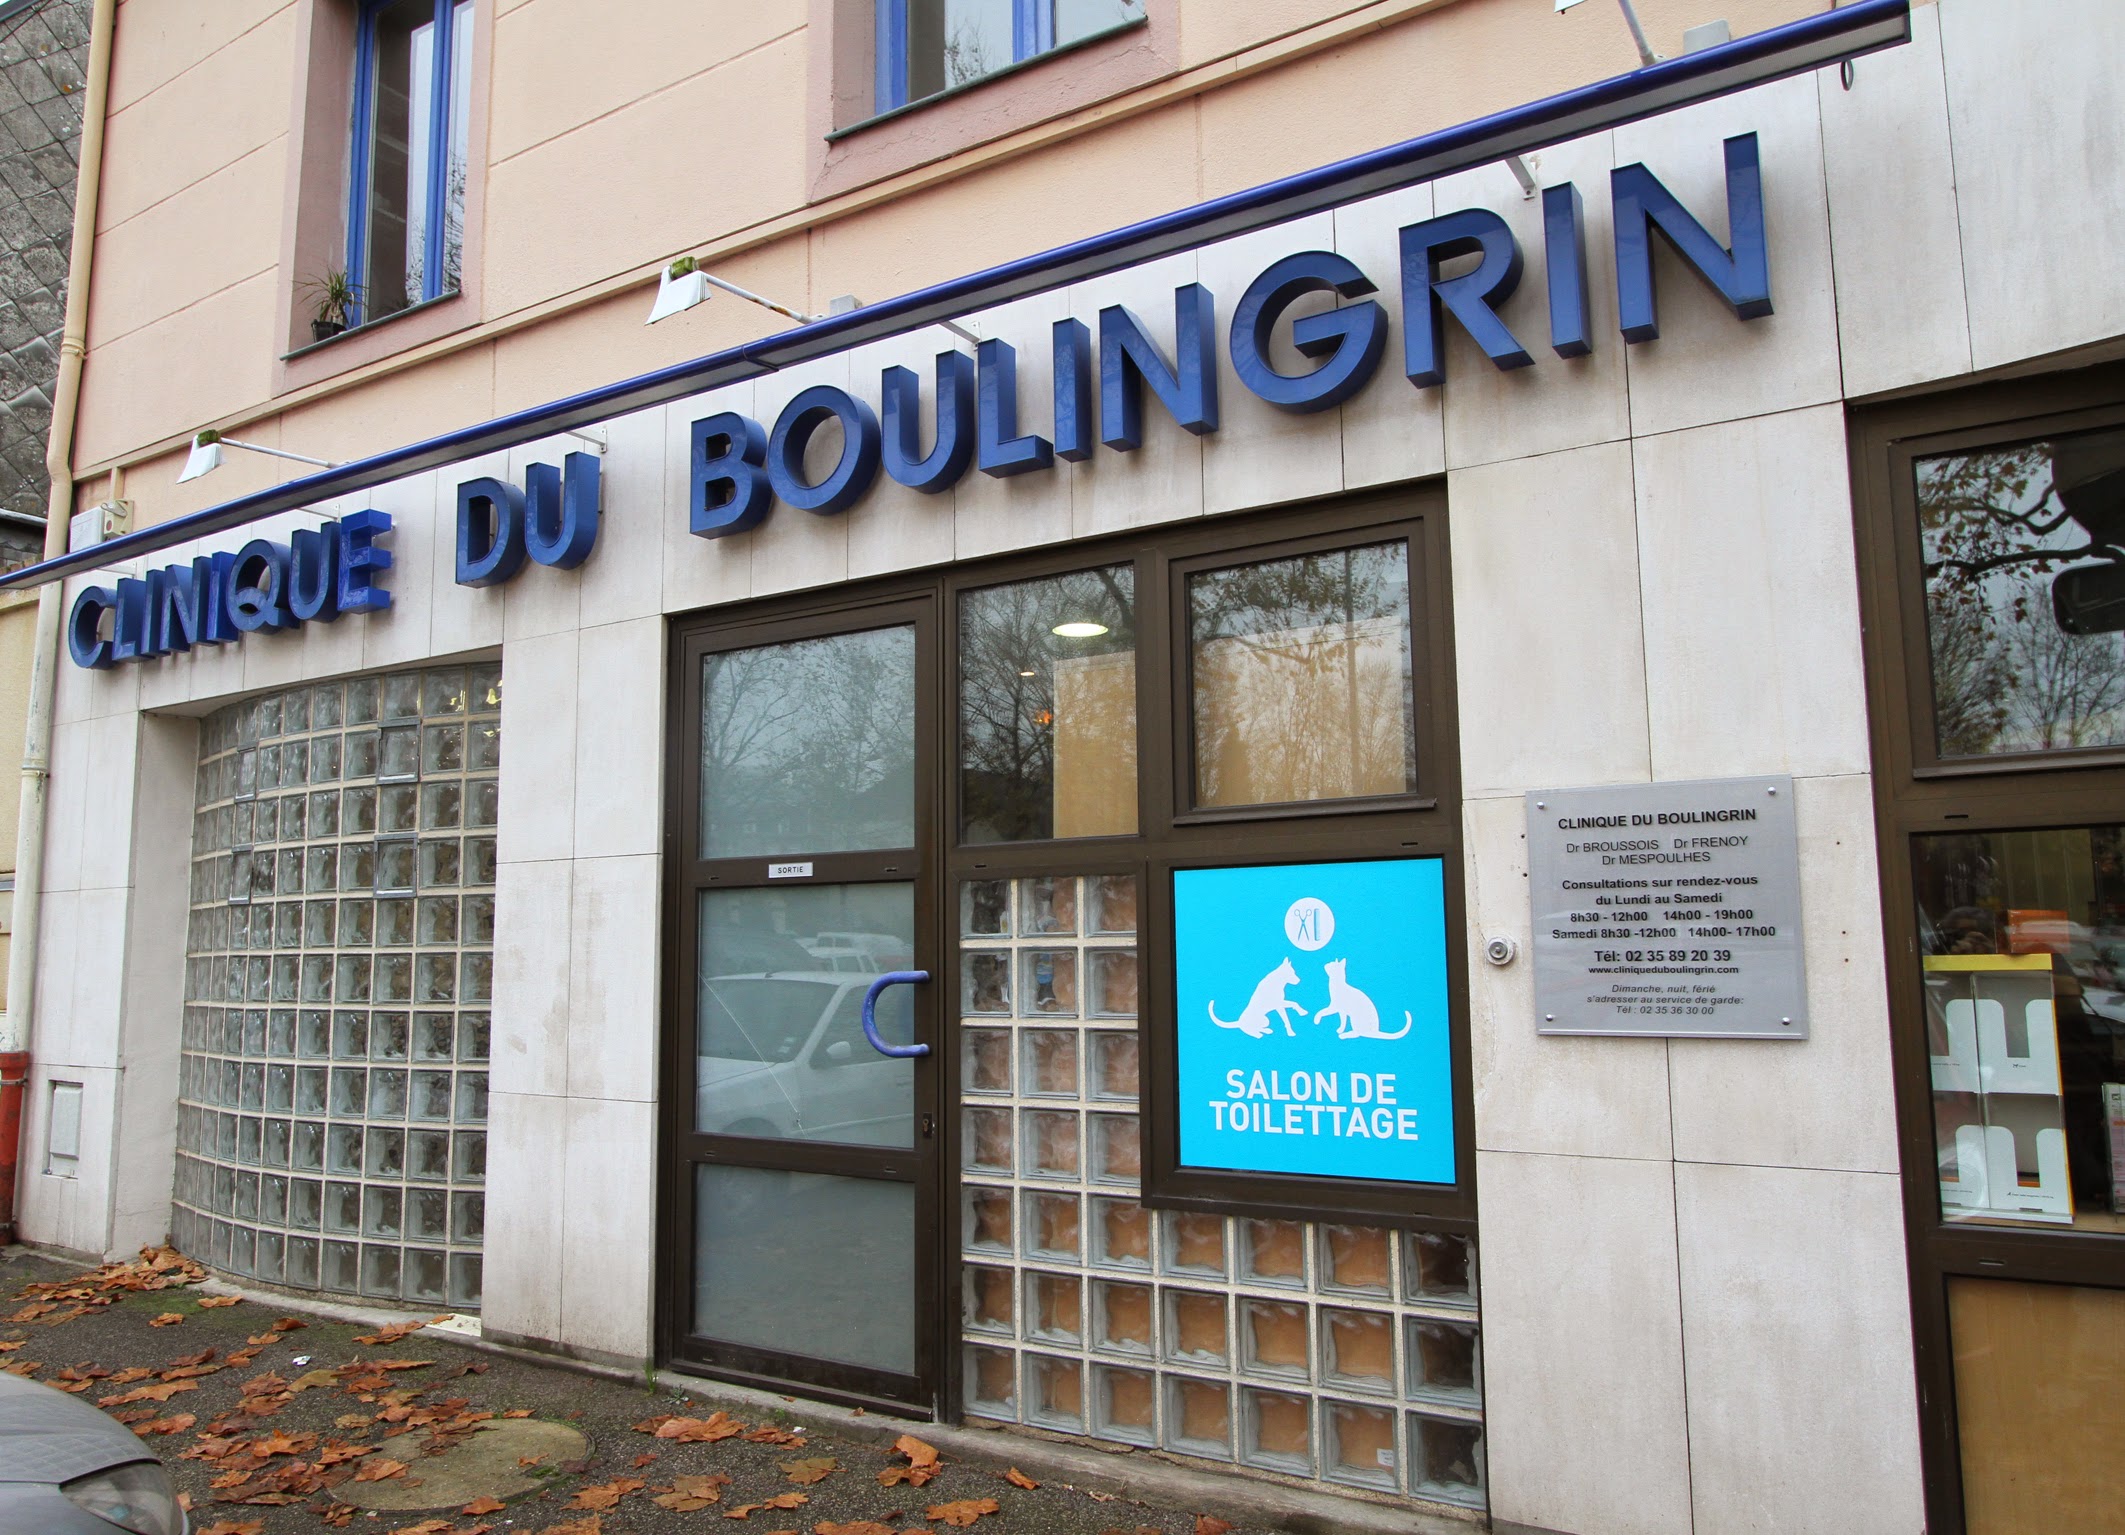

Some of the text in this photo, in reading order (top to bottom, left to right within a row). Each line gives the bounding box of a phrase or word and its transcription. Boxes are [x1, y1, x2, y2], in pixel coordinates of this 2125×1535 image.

[68, 131, 1774, 670] CLINIQUE DU BOULINGRIN
[1558, 808, 1757, 830] CLINIQUE DU BOULINGRIN
[1566, 836, 1748, 853] Dr BROUSSOIS Dr FRENOY
[1602, 852, 1711, 865] Dr MESPOULHES
[778, 866, 804, 874] SORTIE
[1562, 876, 1758, 890] Consultations sur rendez-vous
[1596, 892, 1722, 906] du Lundi au Samedi
[1570, 912, 1599, 922] 8h30
[1612, 912, 1648, 922] 12h00
[1664, 910, 1701, 921] 14h00
[1714, 910, 1754, 920] 19h00
[1552, 928, 1597, 939] Samedi
[1601, 928, 1630, 938] 8h30
[1736, 926, 1776, 936] 17h00
[1594, 950, 1732, 962] Tél: 02 35 89 20 39
[1588, 966, 1739, 976] www.cliniqueduboulingrin.com
[1612, 984, 1716, 994] Dimanche, nuit, férié
[1586, 996, 1638, 1004] s'adresser
[1640, 996, 1653, 1004] au
[1657, 996, 1692, 1004] service
[1694, 996, 1708, 1004] de
[1640, 1006, 1651, 1014] 02
[1653, 1006, 1667, 1014] 35
[1670, 1006, 1683, 1014] 36
[1686, 1006, 1698, 1014] 30
[1701, 1006, 1714, 1014] 00
[1226, 1069, 1397, 1105] SALON DE
[1208, 1100, 1419, 1141] TOILETTAGE
